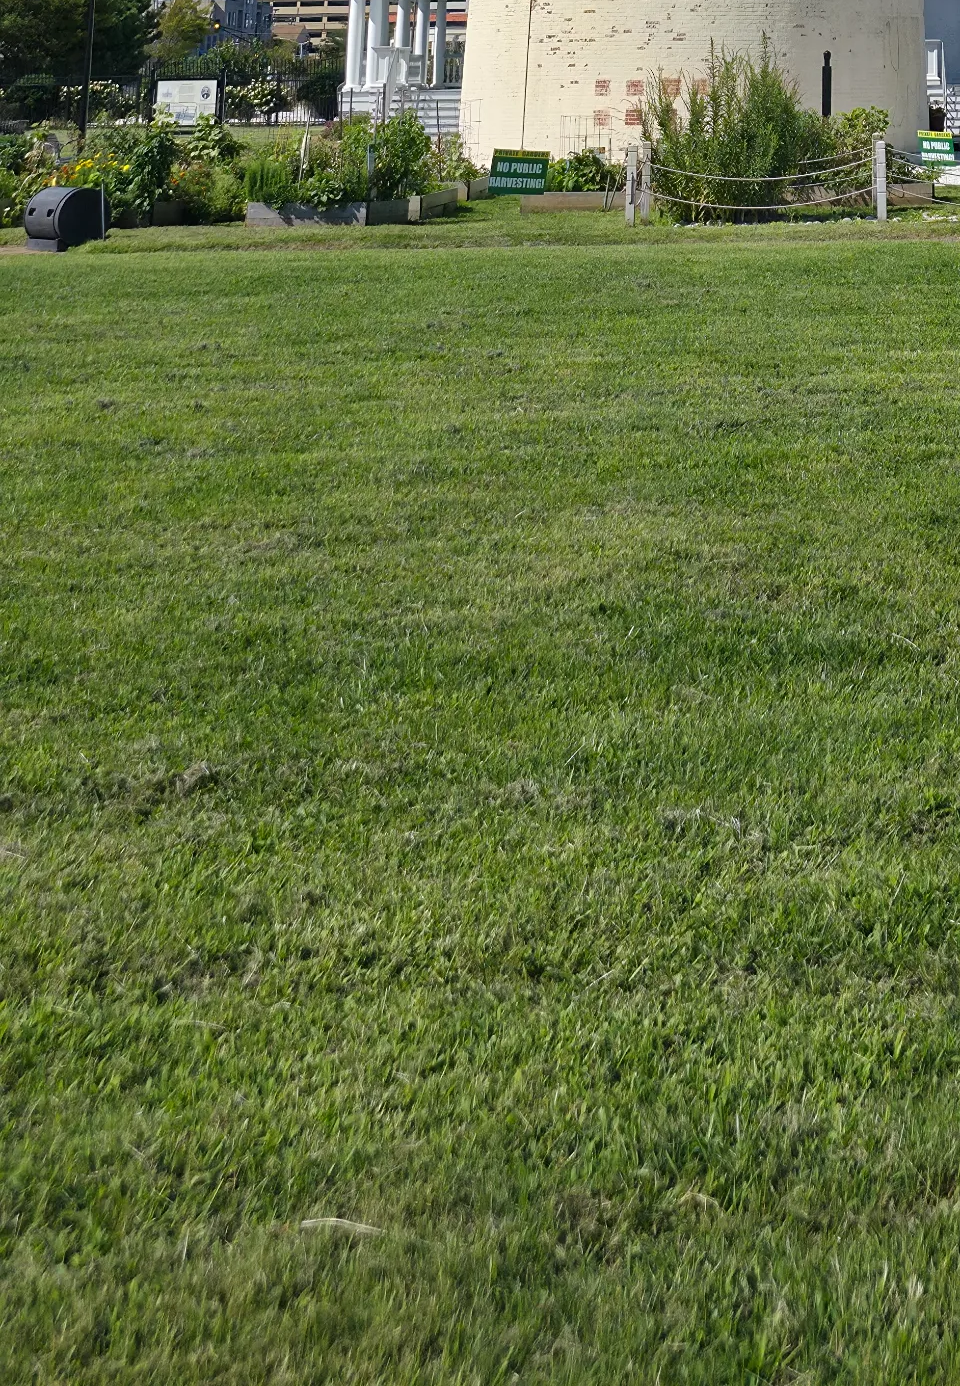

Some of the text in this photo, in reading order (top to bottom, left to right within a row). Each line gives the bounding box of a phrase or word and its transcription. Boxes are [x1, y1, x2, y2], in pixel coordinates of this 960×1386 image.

[497, 162, 543, 173] NO PUBLIC
[489, 176, 545, 188] HARVESTING!
